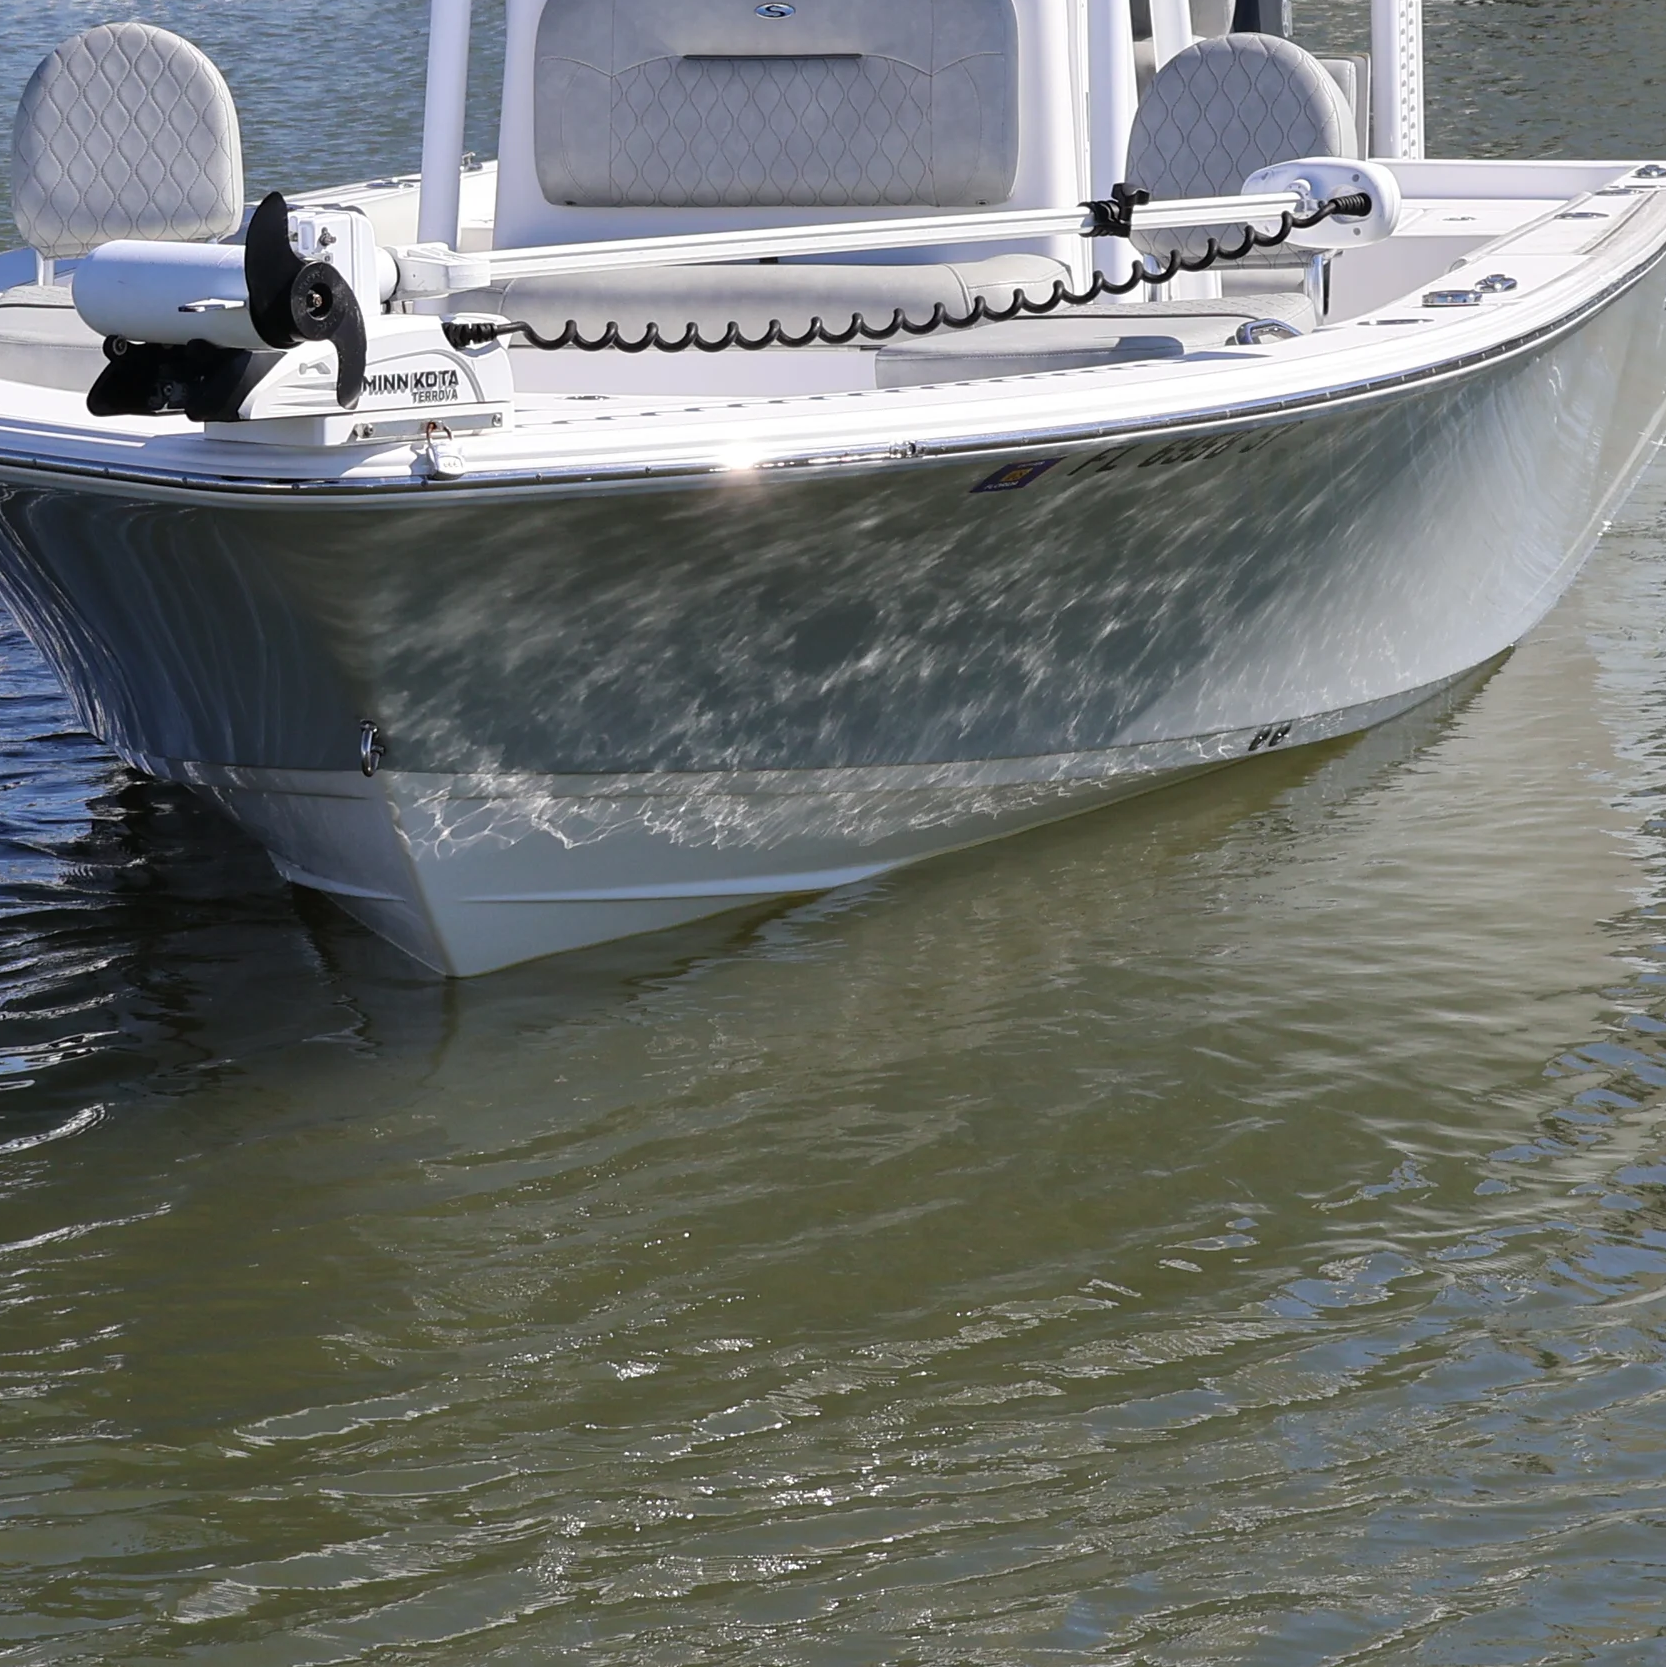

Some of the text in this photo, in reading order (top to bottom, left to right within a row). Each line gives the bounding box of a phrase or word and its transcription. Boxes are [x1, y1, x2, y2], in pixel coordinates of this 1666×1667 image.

[363, 370, 459, 396] MINN KOTA
[412, 388, 459, 404] TERROVA
